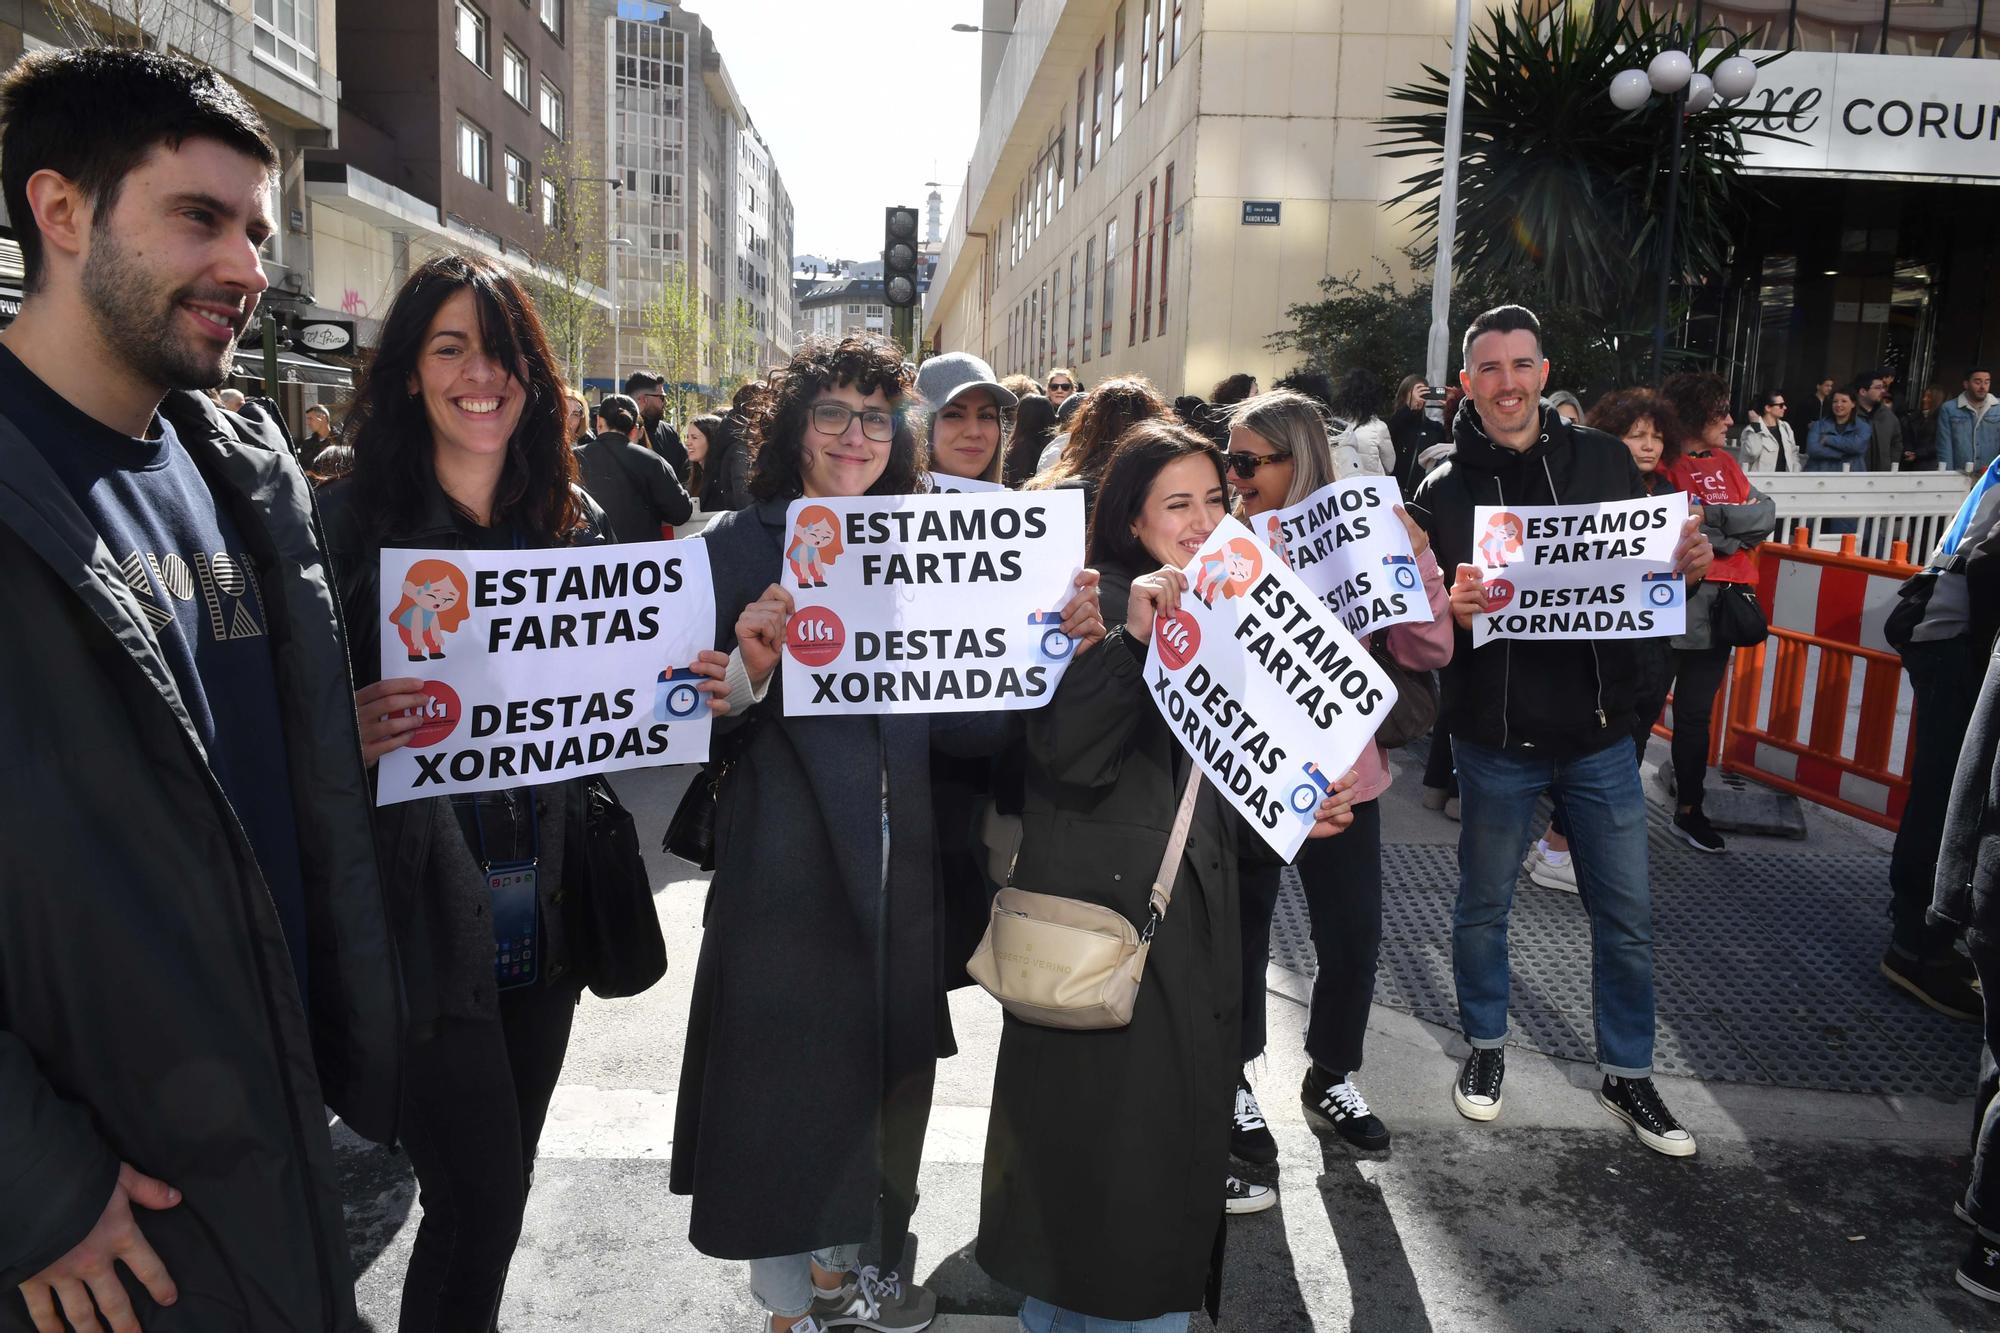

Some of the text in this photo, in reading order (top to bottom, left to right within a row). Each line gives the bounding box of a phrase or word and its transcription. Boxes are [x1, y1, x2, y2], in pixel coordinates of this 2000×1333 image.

[845, 506, 1047, 545] ESTAMOS
[1280, 486, 1381, 544] STAMOS
[1526, 507, 1667, 539] ESTAMOS
[862, 550, 1022, 586] FARTAS
[1534, 537, 1646, 565] FARTAS
[474, 557, 683, 608] ESTAMOS
[1318, 572, 1372, 614] STAS
[1486, 585, 1508, 599] IG
[1519, 584, 1626, 609] DESTAS
[488, 606, 661, 653] FARTAS
[797, 619, 834, 642] CIG
[1162, 618, 1190, 655] CIG
[1487, 610, 1655, 636] XORNADAS
[855, 627, 1007, 662] DESTAS
[1250, 573, 1383, 716] ESTAMOS
[810, 666, 1048, 704] XORNADAS
[1234, 613, 1343, 730] FARTAS
[470, 688, 636, 739] DESTAS
[1184, 663, 1287, 775] DESTAS
[411, 723, 671, 788] XORNADAS
[1154, 665, 1285, 829] XORNADAS
